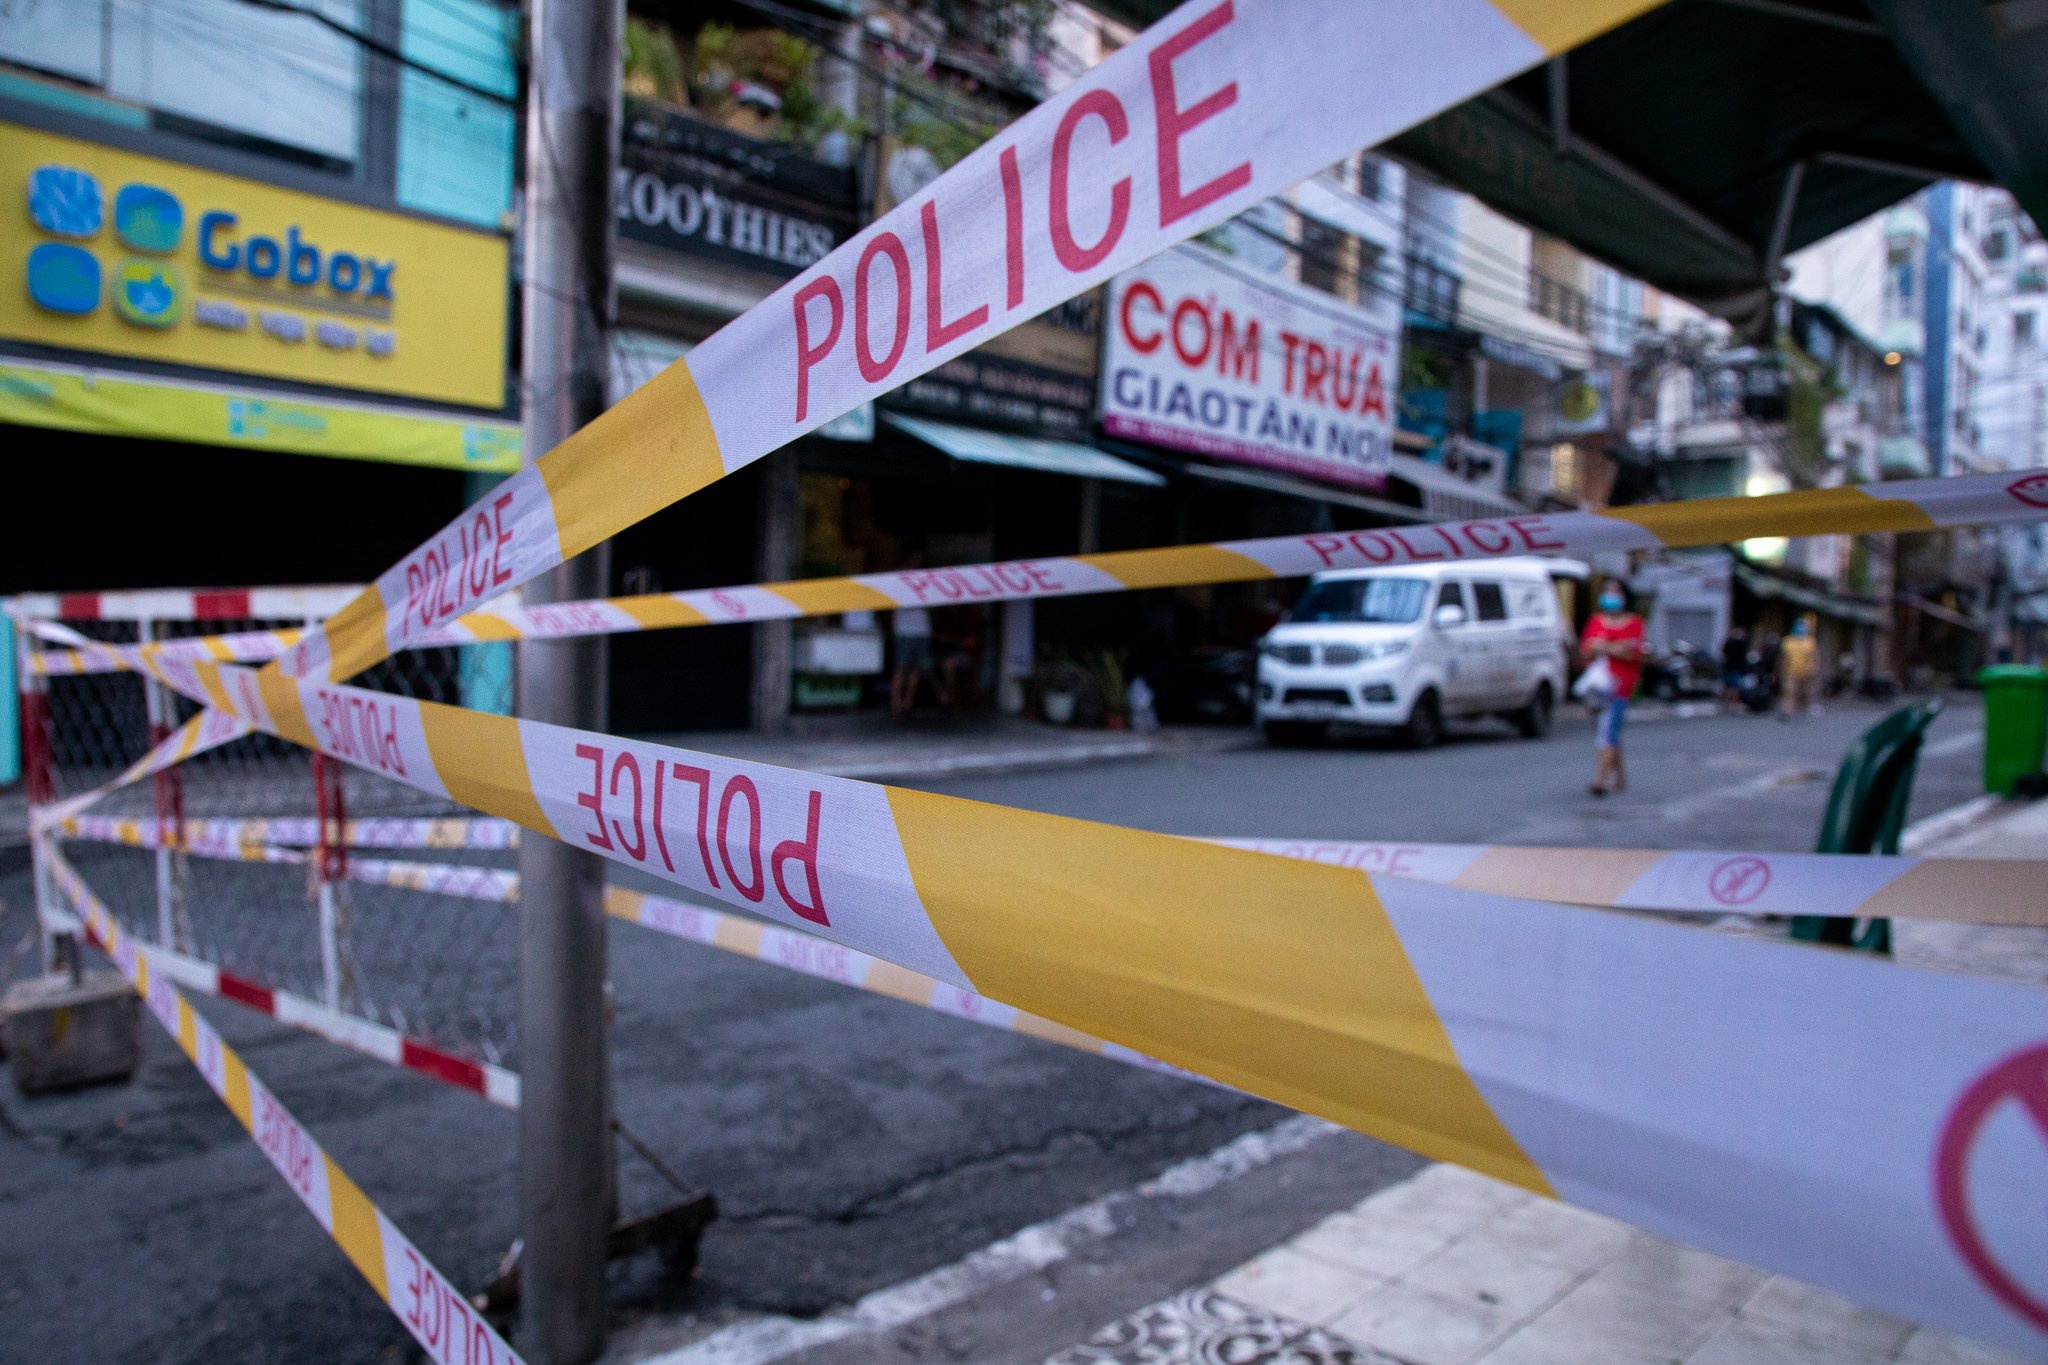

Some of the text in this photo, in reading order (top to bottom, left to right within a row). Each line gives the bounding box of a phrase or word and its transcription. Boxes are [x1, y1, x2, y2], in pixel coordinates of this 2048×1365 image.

[198, 209, 396, 300] Gobox
[794, 0, 1252, 423] POLICE
[402, 492, 513, 638] POLICE
[900, 559, 1066, 604] POLICE
[1302, 513, 1566, 568] POLICE
[316, 690, 408, 778] POLICE
[576, 743, 831, 928] POLICE
[405, 1248, 515, 1365] OLICE
